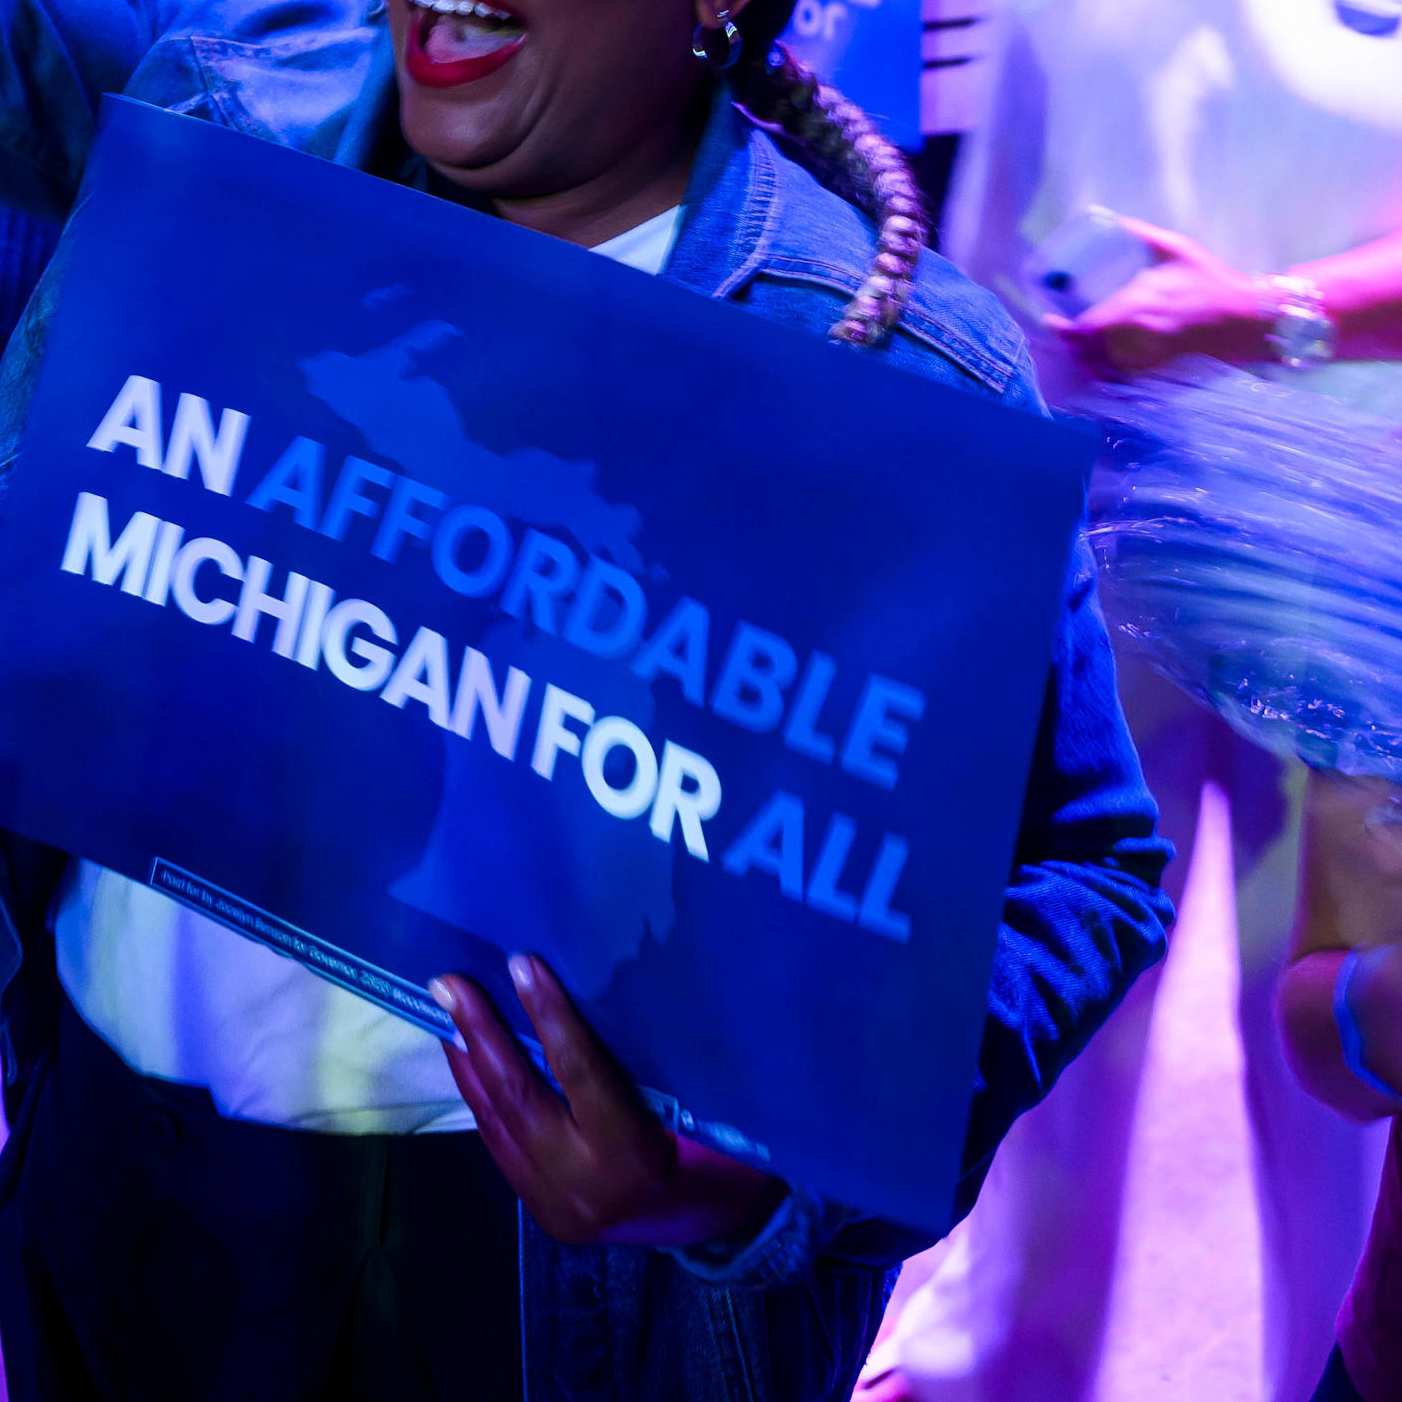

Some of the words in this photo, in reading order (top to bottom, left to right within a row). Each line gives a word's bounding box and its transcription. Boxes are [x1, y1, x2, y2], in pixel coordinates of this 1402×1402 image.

[60, 492, 532, 761] MICHIGAN
[531, 683, 723, 862] FOR
[723, 788, 911, 942] ALL
[86, 374, 250, 496] AN
[248, 436, 926, 786] AFFORDABLE
